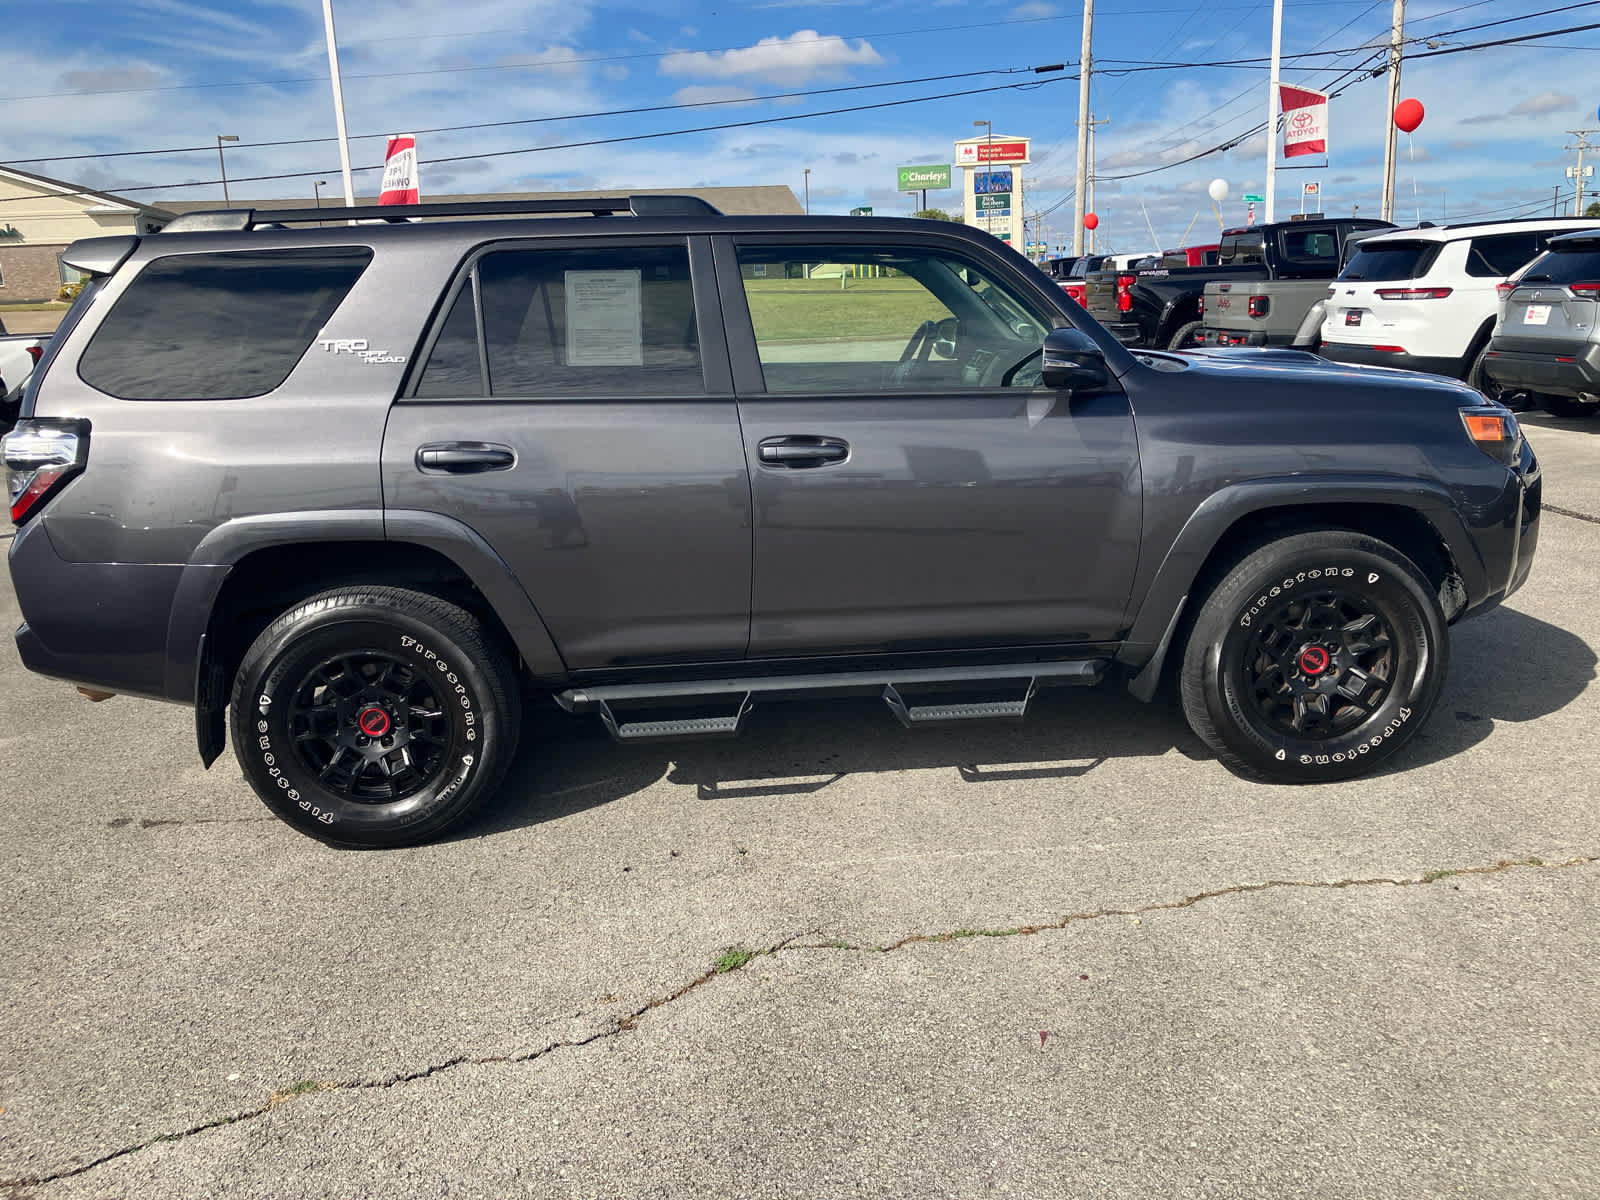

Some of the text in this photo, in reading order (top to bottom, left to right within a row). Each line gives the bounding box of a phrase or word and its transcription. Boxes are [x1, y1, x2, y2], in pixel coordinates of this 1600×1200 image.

[1241, 567, 1354, 627] Firestone
[400, 635, 476, 741] Firestone
[258, 719, 335, 825] Firestone
[1300, 706, 1412, 765] Firestone
